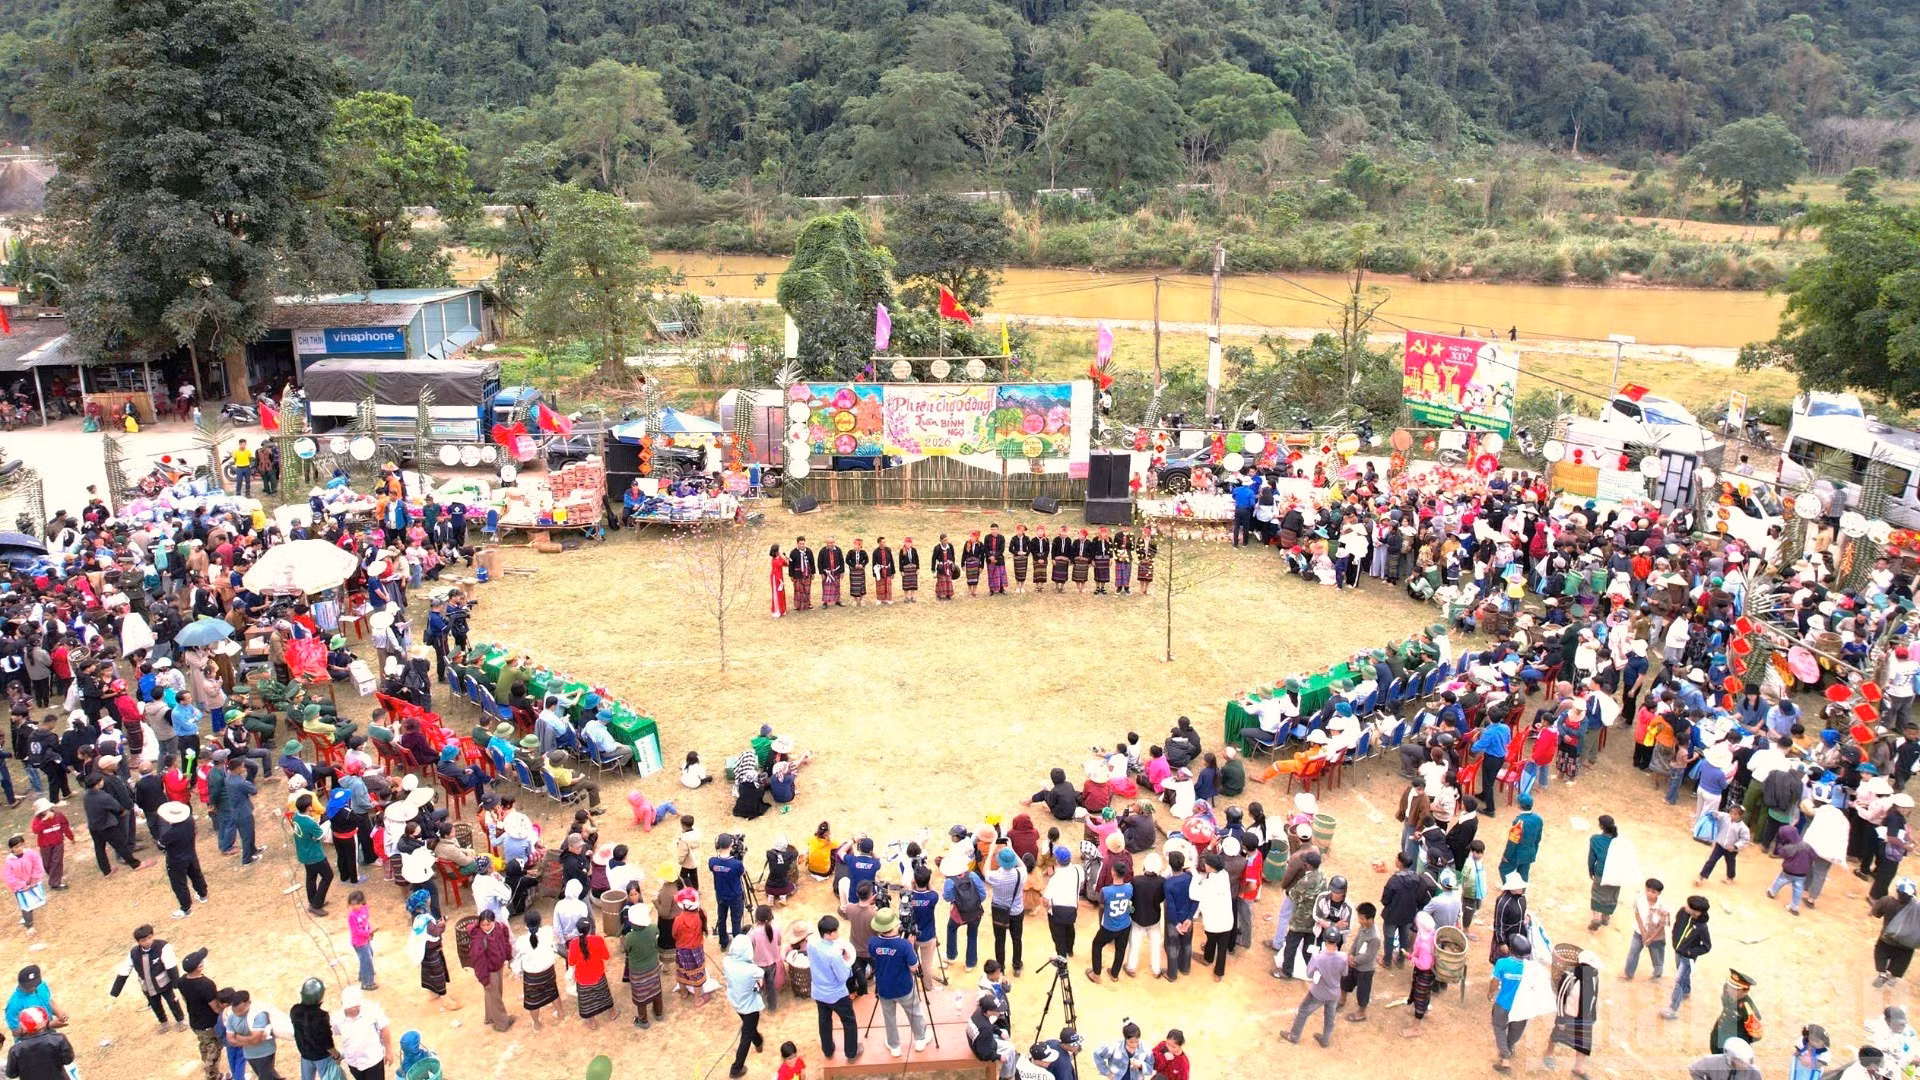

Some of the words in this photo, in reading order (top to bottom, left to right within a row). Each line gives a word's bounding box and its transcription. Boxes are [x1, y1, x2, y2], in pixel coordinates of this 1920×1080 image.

[333, 331, 395, 343] vinaphone
[1451, 351, 1470, 362] XIV
[893, 397, 934, 413] Phiên
[947, 428, 965, 438] NGỌ
[925, 438, 952, 448] 2026
[1109, 898, 1129, 917] 59
